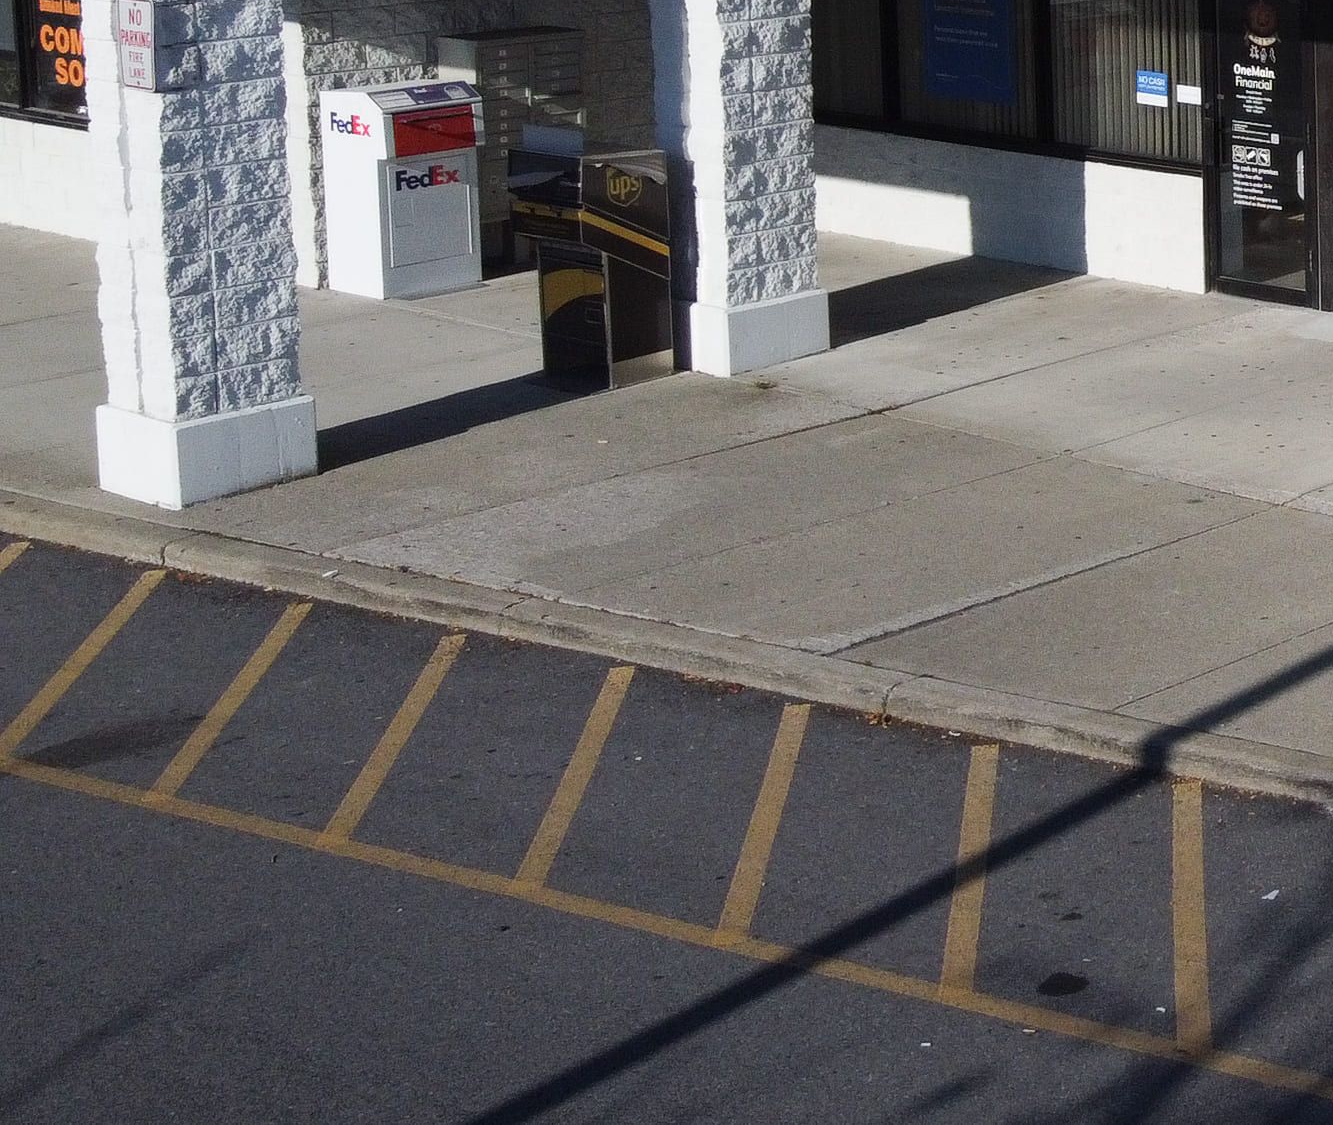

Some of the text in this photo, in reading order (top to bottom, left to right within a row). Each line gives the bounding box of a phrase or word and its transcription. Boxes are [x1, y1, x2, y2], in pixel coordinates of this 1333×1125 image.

[128, 8, 142, 26] NO
[121, 28, 152, 49] PARKING
[1235, 76, 1273, 91] Financial
[330, 112, 371, 137] FedEx
[395, 165, 460, 191] FedEx
[610, 175, 639, 200] ups
